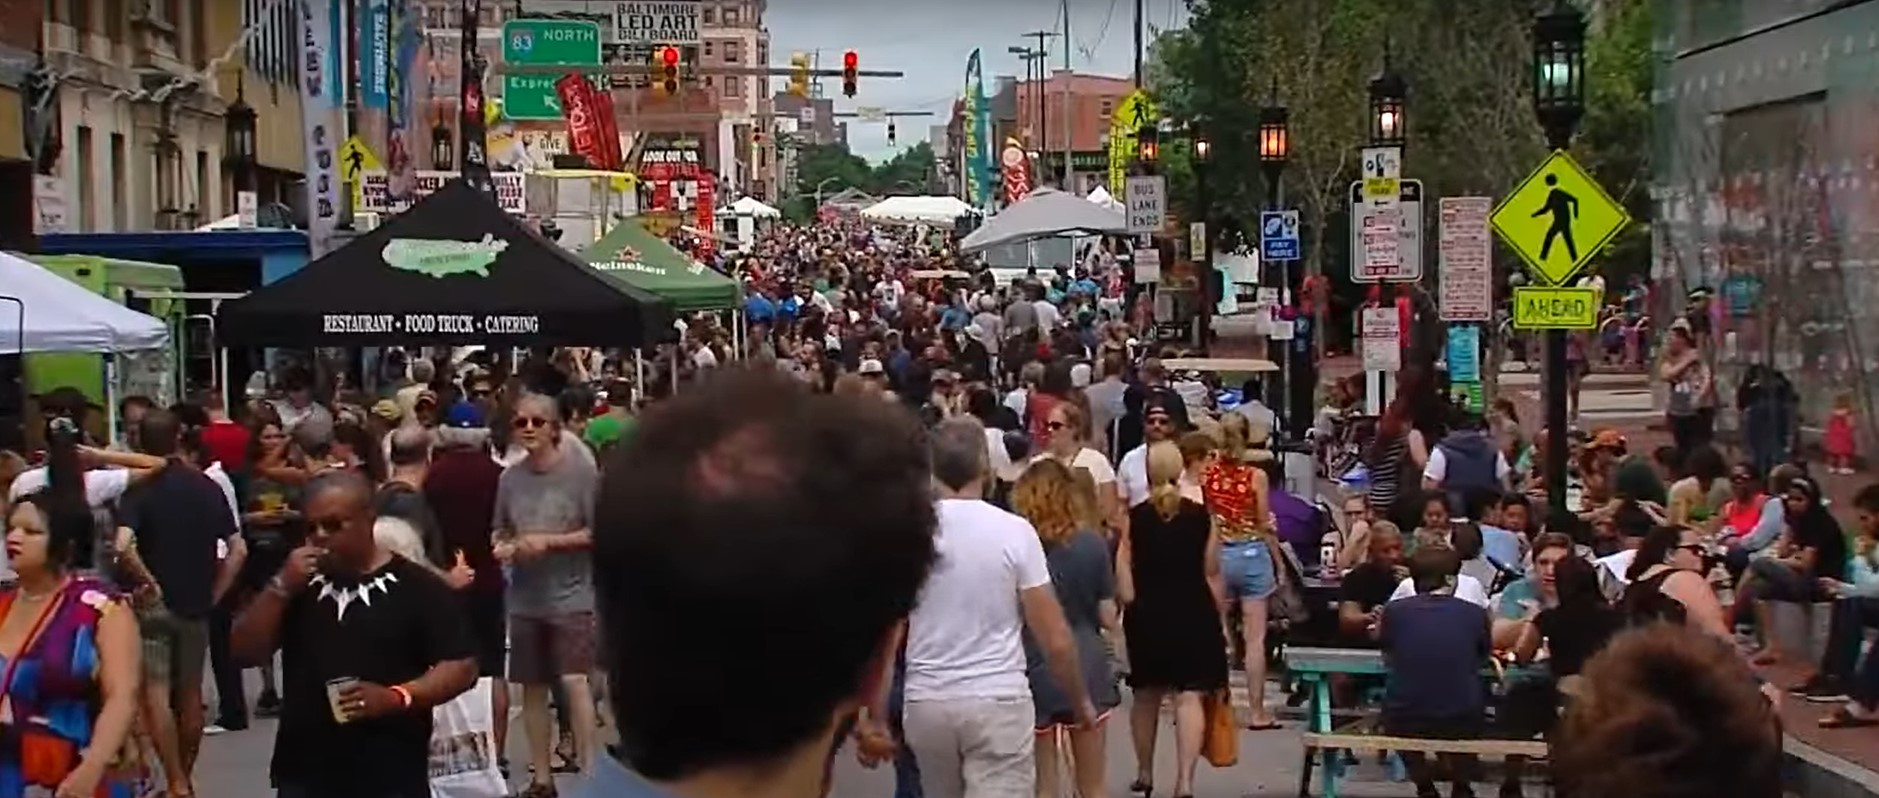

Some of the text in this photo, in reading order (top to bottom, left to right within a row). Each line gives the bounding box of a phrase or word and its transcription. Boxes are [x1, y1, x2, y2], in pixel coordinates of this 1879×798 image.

[616, 3, 699, 15] BALTIMORE
[617, 16, 699, 29] LED ART
[543, 29, 595, 41] NORTH
[617, 29, 699, 41] BILLBOARD
[511, 35, 533, 51] 83
[539, 138, 561, 149] GIVE
[643, 150, 664, 162] LOOK
[1134, 184, 1155, 196] BUS
[1132, 200, 1157, 212] LANE
[1132, 215, 1160, 228] ENDS
[1526, 298, 1586, 317] AHEAD
[323, 314, 539, 334] RESTAURANT FOOD TRUCK CATERING
